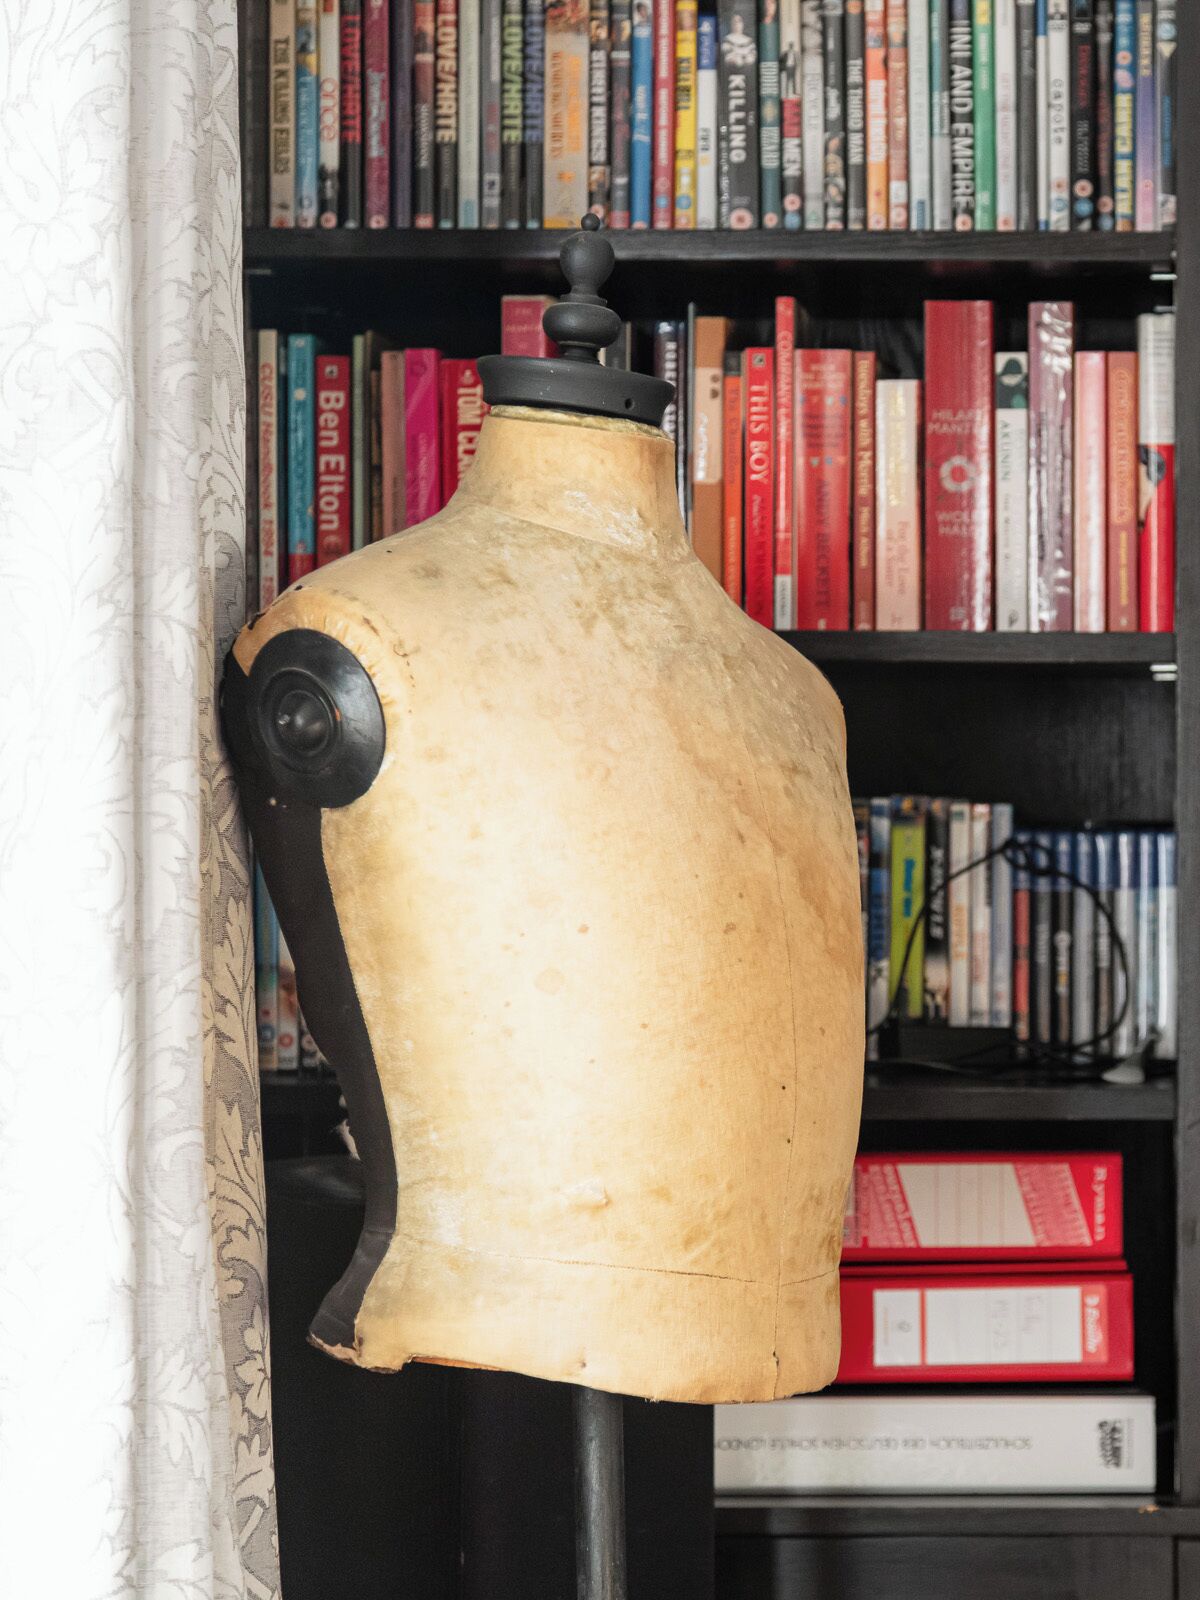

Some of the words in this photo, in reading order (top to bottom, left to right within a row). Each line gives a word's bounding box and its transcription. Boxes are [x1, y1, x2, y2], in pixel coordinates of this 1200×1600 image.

[273, 69, 290, 124] KILLING
[341, 14, 361, 144] LOVE/HATE
[436, 13, 457, 143] LOVE/HATE
[503, 13, 523, 144] LOVE/HATE
[525, 13, 543, 144] LOVE/HATE
[847, 58, 864, 85] THE
[320, 79, 339, 142] once
[728, 74, 746, 163] KILLING
[847, 88, 864, 129] THIRD
[273, 128, 290, 175] FIELDS
[783, 138, 801, 177] MEN
[847, 132, 864, 165] MAN
[951, 122, 973, 209] EMPIRE
[260, 363, 274, 416] CUSU
[778, 331, 792, 405] COMPANY
[318, 390, 345, 447] Ben
[458, 384, 482, 425] TOM
[749, 381, 769, 434] THIS
[858, 418, 871, 449] with
[1000, 420, 1012, 481] AKUNIN
[260, 420, 274, 511] Handbook
[748, 441, 769, 484] BOY
[858, 451, 872, 497] Morrie
[318, 454, 345, 531] Elton
[815, 479, 830, 528] ANDY
[815, 533, 830, 610] BECKETT
[859, 536, 870, 569] Albom
[1092, 1166, 1108, 1241] Ryman
